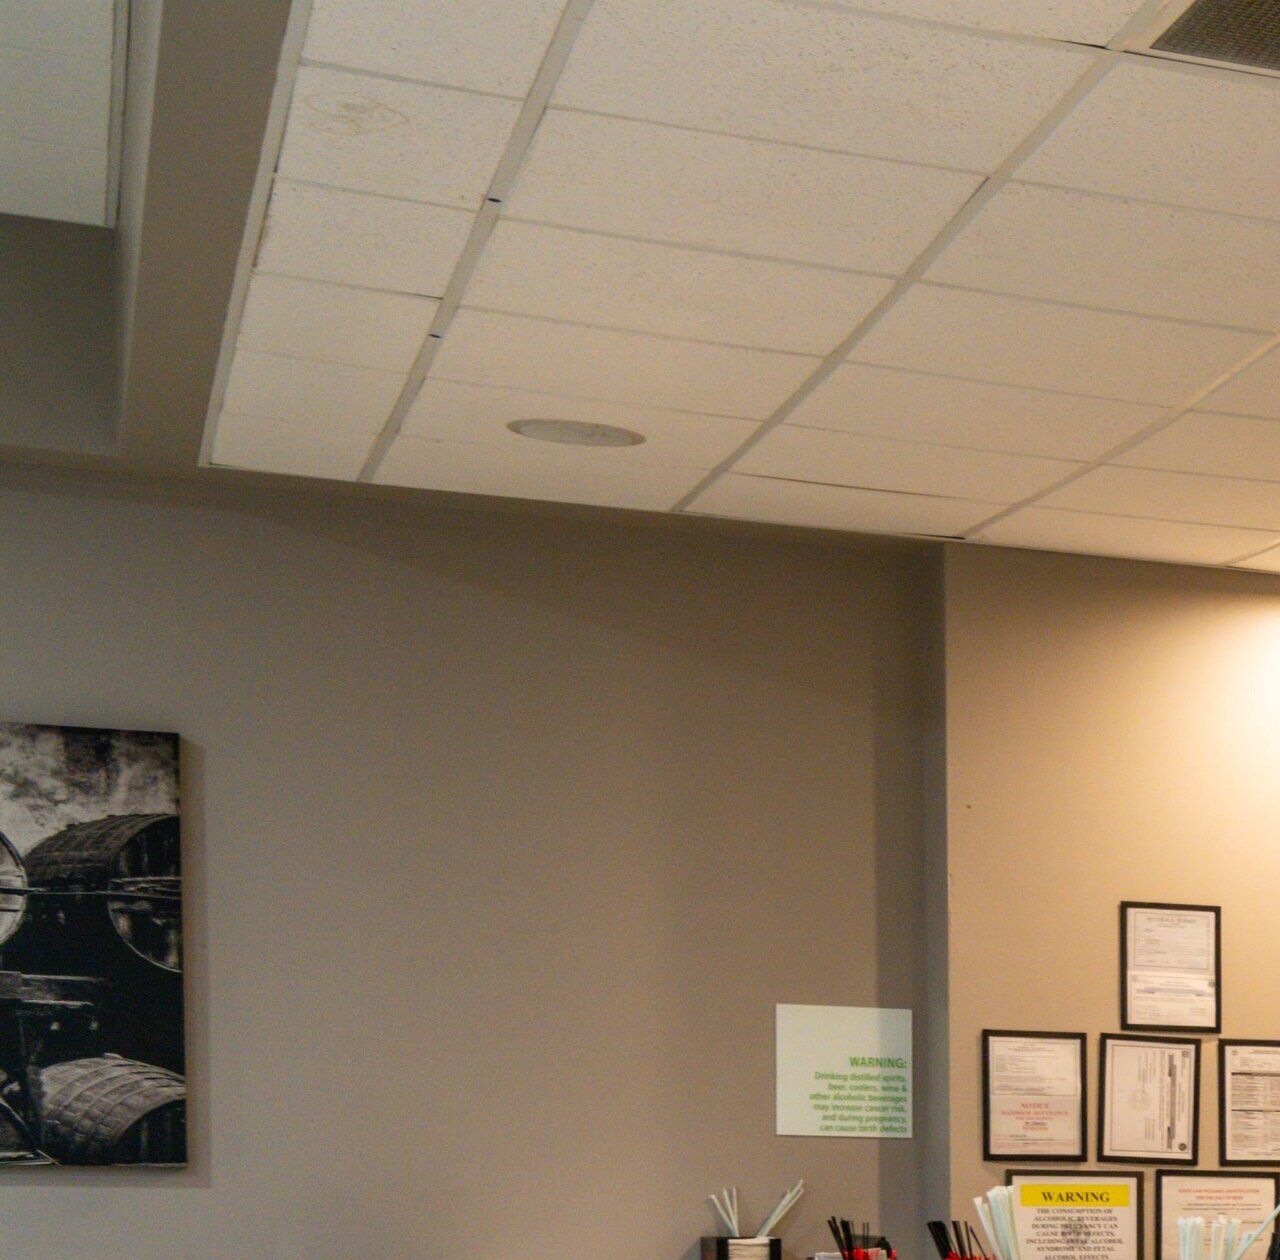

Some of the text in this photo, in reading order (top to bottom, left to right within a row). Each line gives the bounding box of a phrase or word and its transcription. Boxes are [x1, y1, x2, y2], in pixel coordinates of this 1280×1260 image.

[849, 1057, 907, 1068] WARNING:
[814, 1071, 848, 1081] Drinking
[849, 1073, 880, 1081] distilled
[868, 1094, 907, 1103] beverages
[813, 1104, 829, 1112] may
[838, 1114, 864, 1123] during
[879, 1125, 907, 1133] defects
[1042, 1192, 1110, 1202] WARNING
